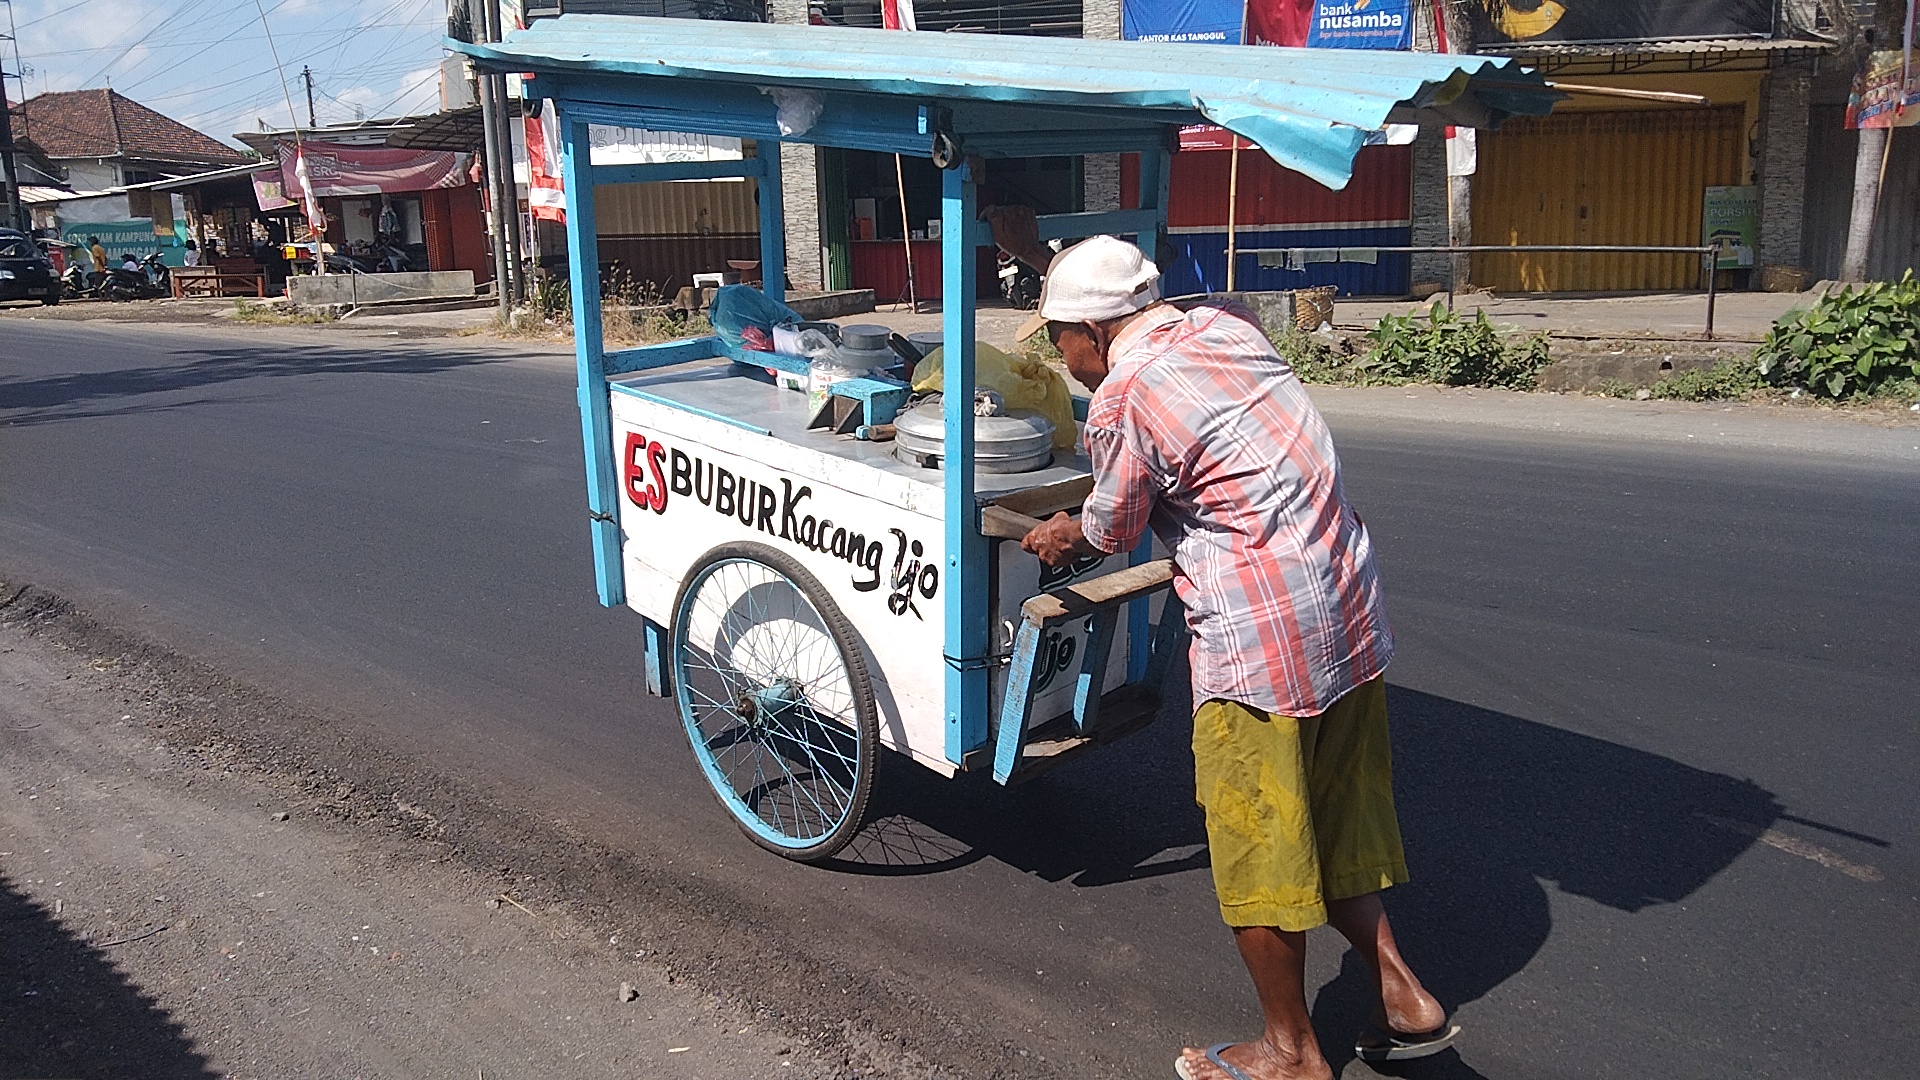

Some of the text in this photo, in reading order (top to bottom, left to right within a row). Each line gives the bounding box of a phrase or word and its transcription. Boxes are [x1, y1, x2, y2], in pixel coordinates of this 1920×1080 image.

[1320, 3, 1352, 16] bank
[1320, 11, 1402, 29] nusamba
[1138, 34, 1169, 42] KANTOR
[1188, 32, 1226, 40] TANGGUL
[115, 231, 156, 243] KAMPUNG
[624, 431, 668, 515] ES
[671, 447, 776, 536] BUBUR
[778, 477, 883, 592] Kacang
